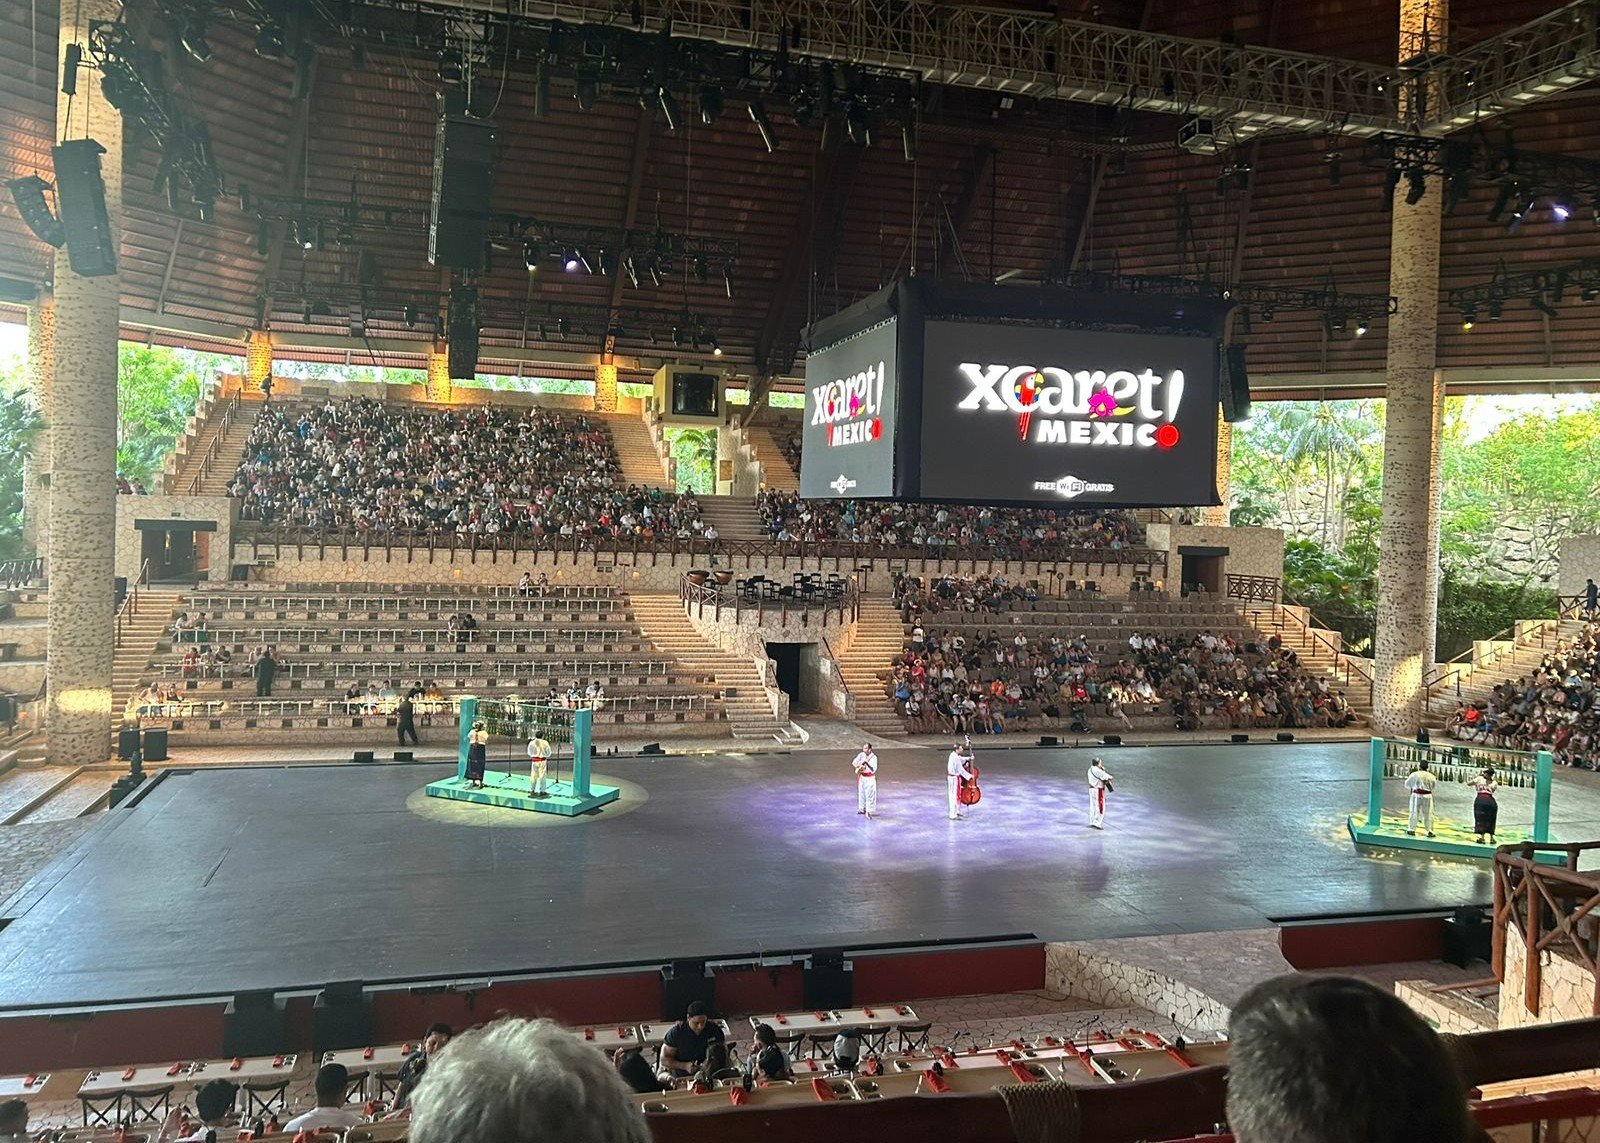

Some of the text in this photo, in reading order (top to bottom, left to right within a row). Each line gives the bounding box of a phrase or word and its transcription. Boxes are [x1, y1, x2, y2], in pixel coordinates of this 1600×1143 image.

[832, 417, 883, 447] MEXICO
[1036, 418, 1181, 448] MEXICO
[1034, 481, 1056, 490] FREE
[1085, 483, 1115, 493] GRATIS
